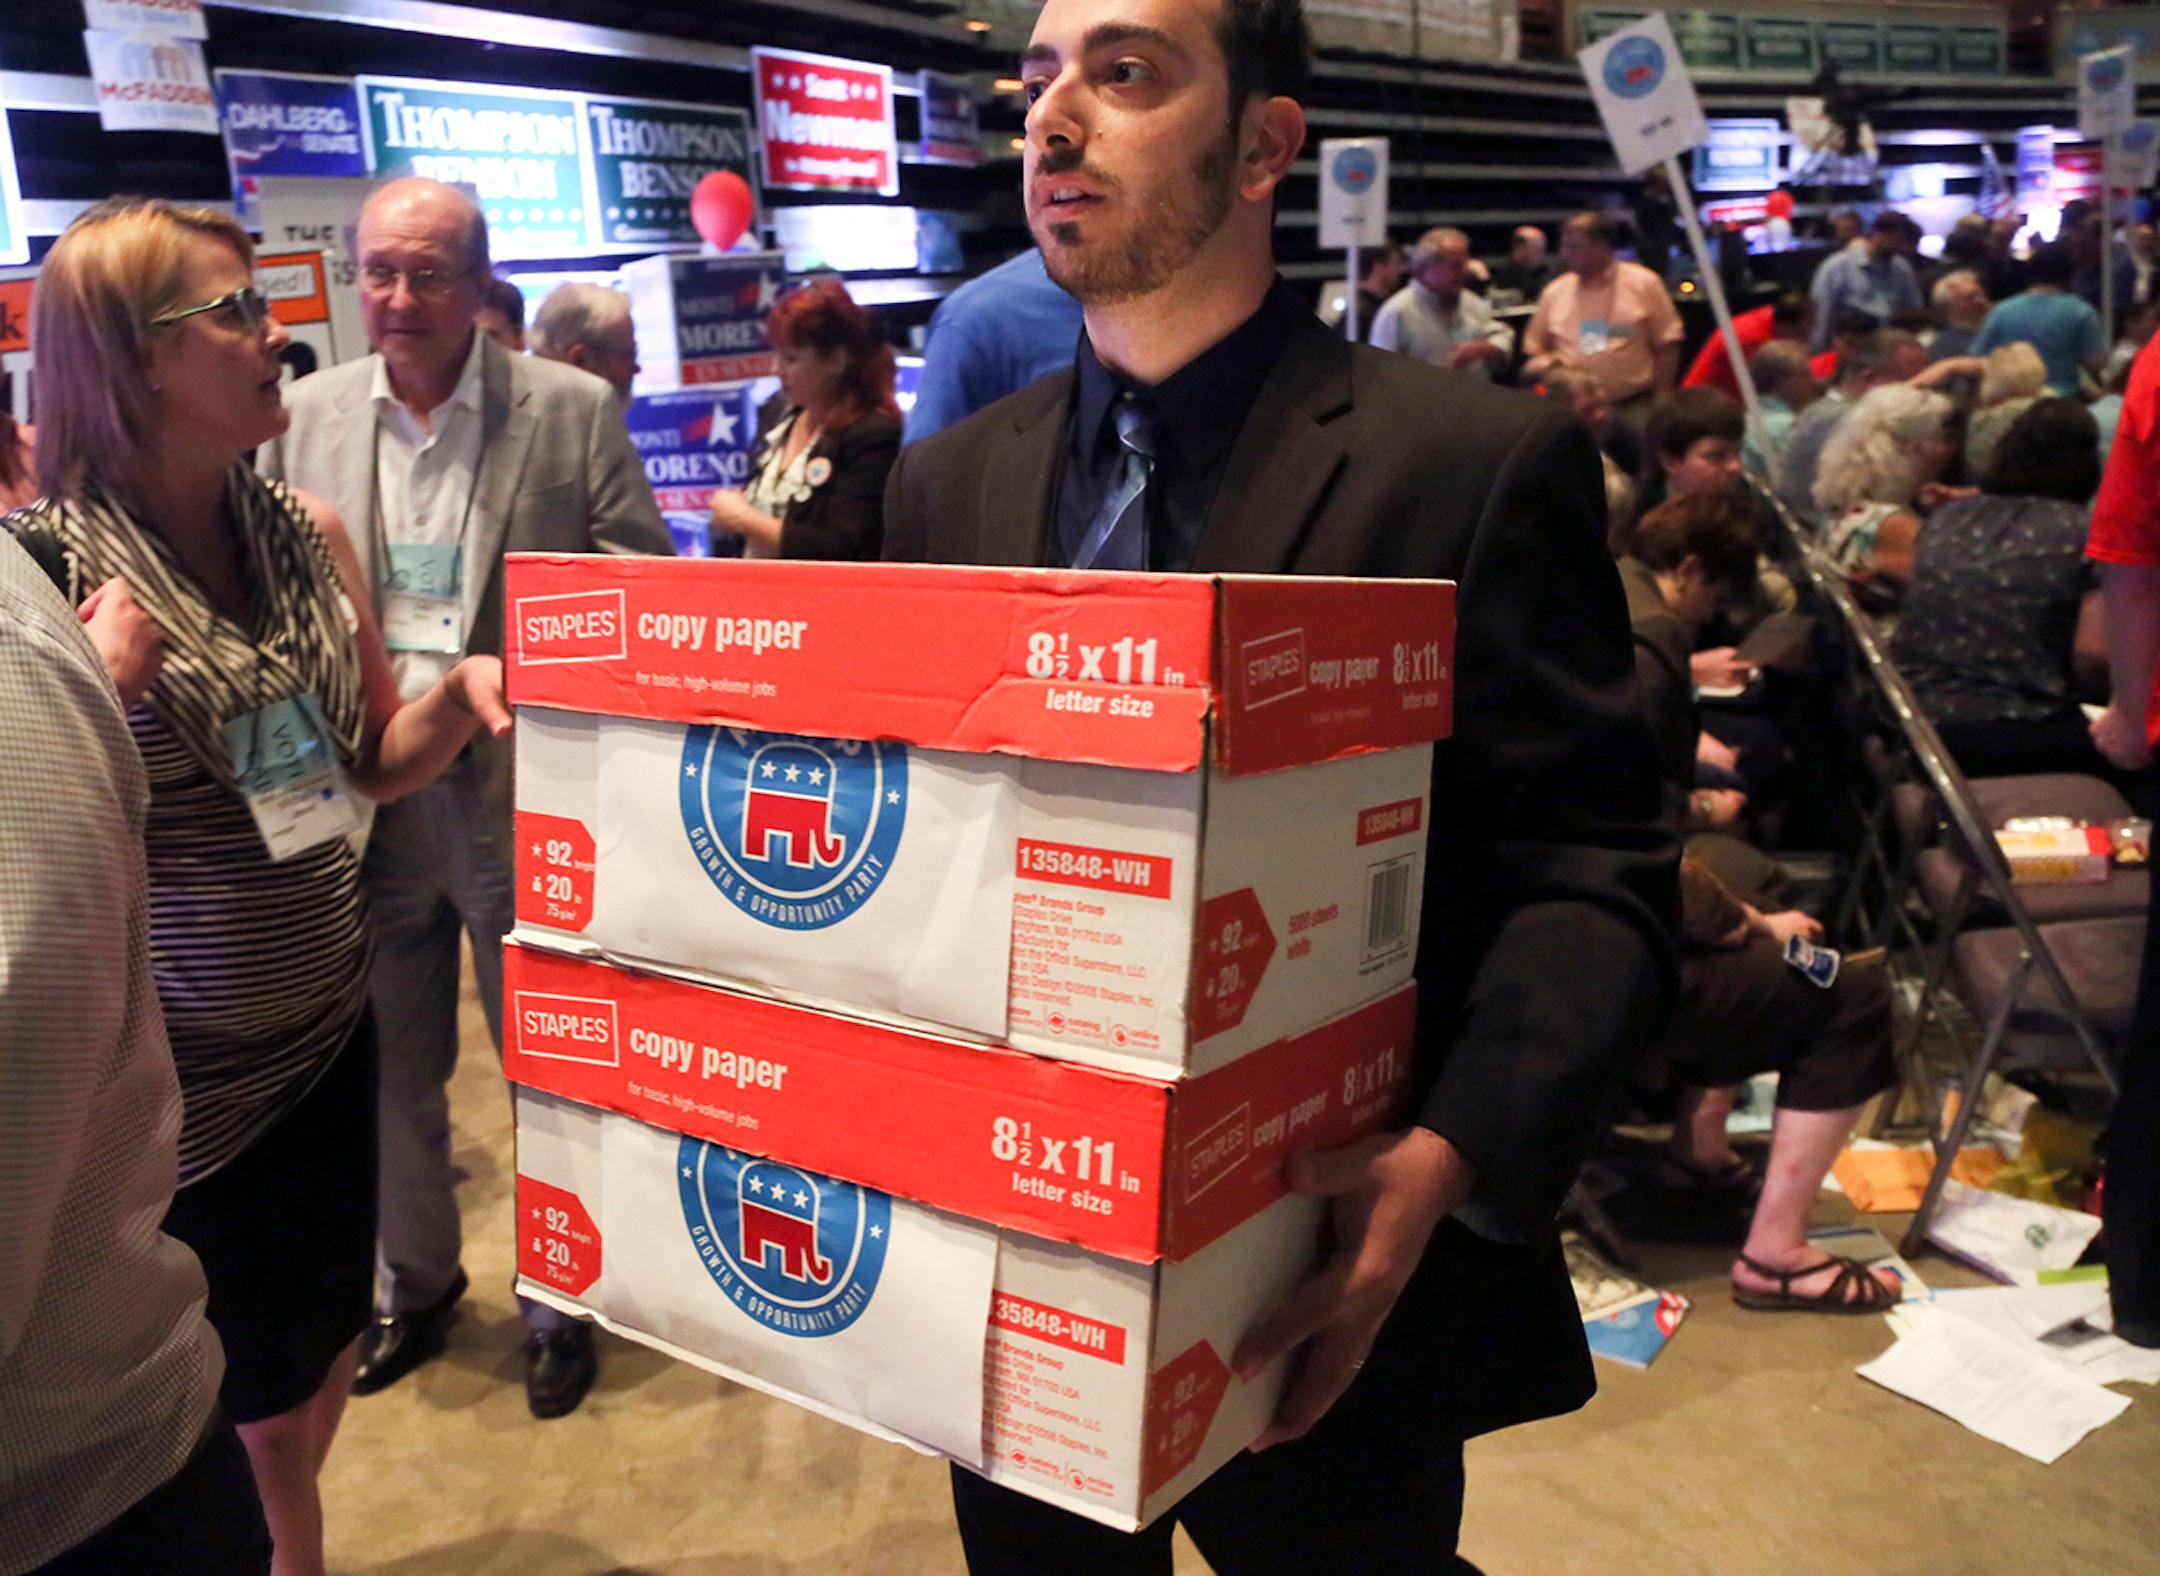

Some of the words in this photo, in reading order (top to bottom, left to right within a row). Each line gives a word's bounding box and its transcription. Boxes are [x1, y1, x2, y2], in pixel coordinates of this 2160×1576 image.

[228, 102, 347, 132] DAHLBERG
[590, 106, 744, 158] THOMPSON
[526, 610, 616, 643] STAPLES
[638, 612, 707, 650] copy
[716, 617, 807, 655] paper
[1249, 647, 1299, 686] STAPLES
[1310, 660, 1342, 689] copy
[1345, 658, 1379, 687] paper
[636, 671, 651, 686] for
[653, 673, 682, 690] basic,
[684, 675, 750, 694] high-volume
[752, 680, 777, 698] jobs
[1046, 688, 1104, 713] letter
[1109, 694, 1154, 718] size
[546, 839, 572, 867] 92
[1019, 846, 1151, 886] 135848-WH
[546, 874, 572, 902] 20
[689, 826, 736, 890] GROWTH
[735, 886, 745, 902] &
[750, 895, 846, 923] OPPORTUNITY
[845, 853, 883, 903] PARTY
[1221, 920, 1242, 954] 92
[1218, 963, 1240, 998] 20
[524, 1010, 609, 1043] STAPLES
[629, 1027, 694, 1073] copy
[702, 1045, 788, 1090] paper
[628, 1081, 642, 1097] for
[643, 1086, 671, 1106] basic,
[672, 1094, 734, 1123] high-volume
[736, 1110, 759, 1130] jobs
[1253, 1112, 1288, 1148] copy
[1289, 1091, 1329, 1134] paper
[1011, 1171, 1067, 1203] letter
[1071, 1189, 1113, 1216] size
[545, 1206, 569, 1236] 92
[546, 1238, 570, 1267] 20
[692, 1224, 733, 1286] GROWTH
[734, 1285, 745, 1301] &
[748, 1296, 836, 1331] OPPORTUNITY
[835, 1281, 867, 1319] PARTY
